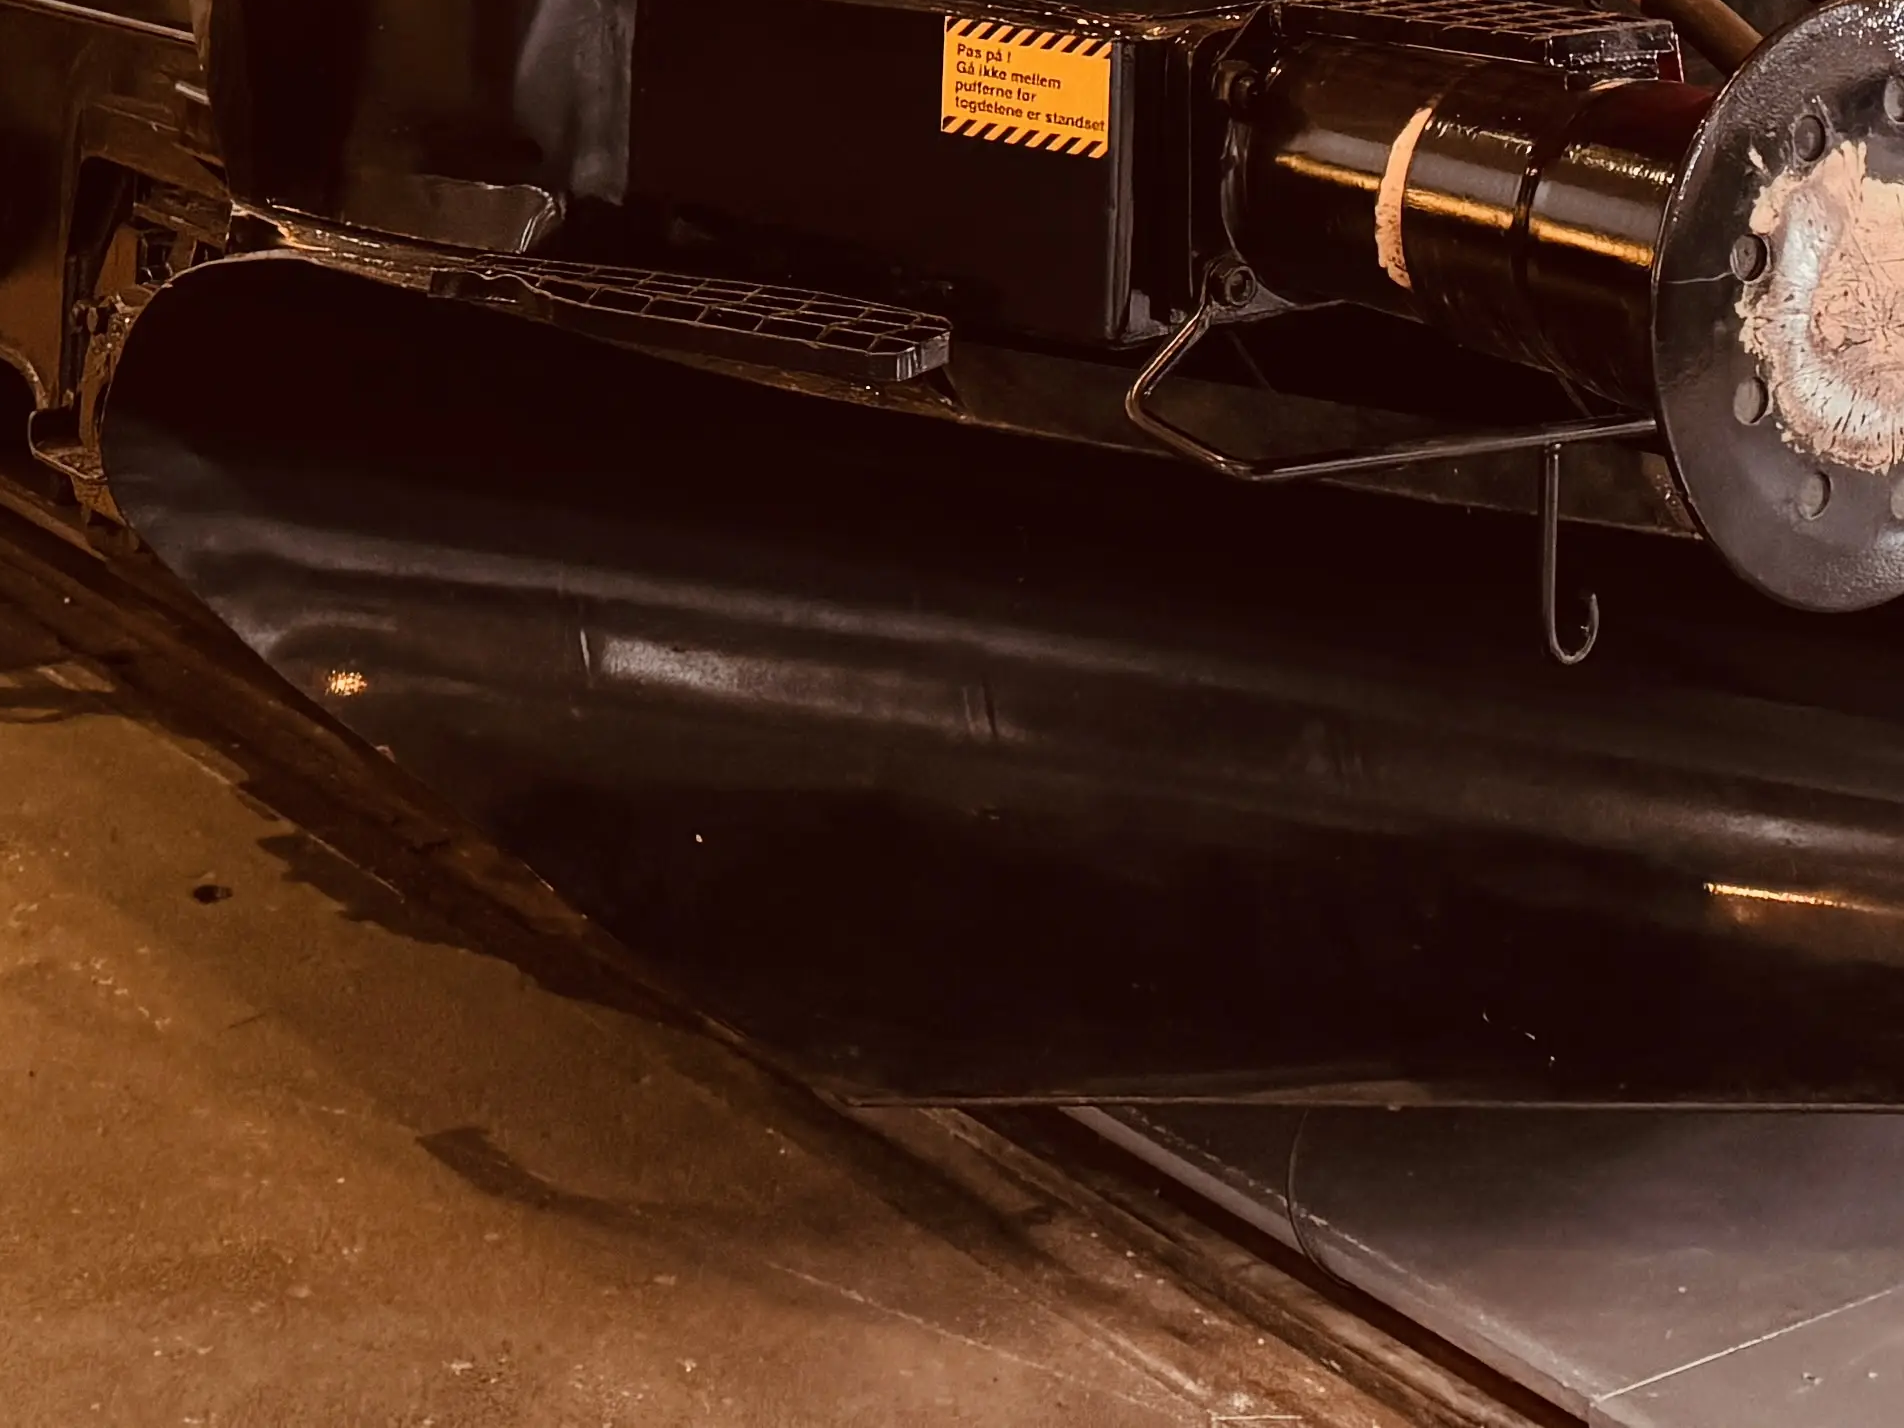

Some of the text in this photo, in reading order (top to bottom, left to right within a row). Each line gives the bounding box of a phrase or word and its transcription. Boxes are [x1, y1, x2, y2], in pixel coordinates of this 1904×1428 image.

[957, 43, 982, 59] Pas
[986, 48, 1003, 63] på
[956, 60, 1061, 90] Gå ikke mellem
[955, 80, 1013, 99] pufferne
[955, 96, 1105, 132] togdelene er standset
